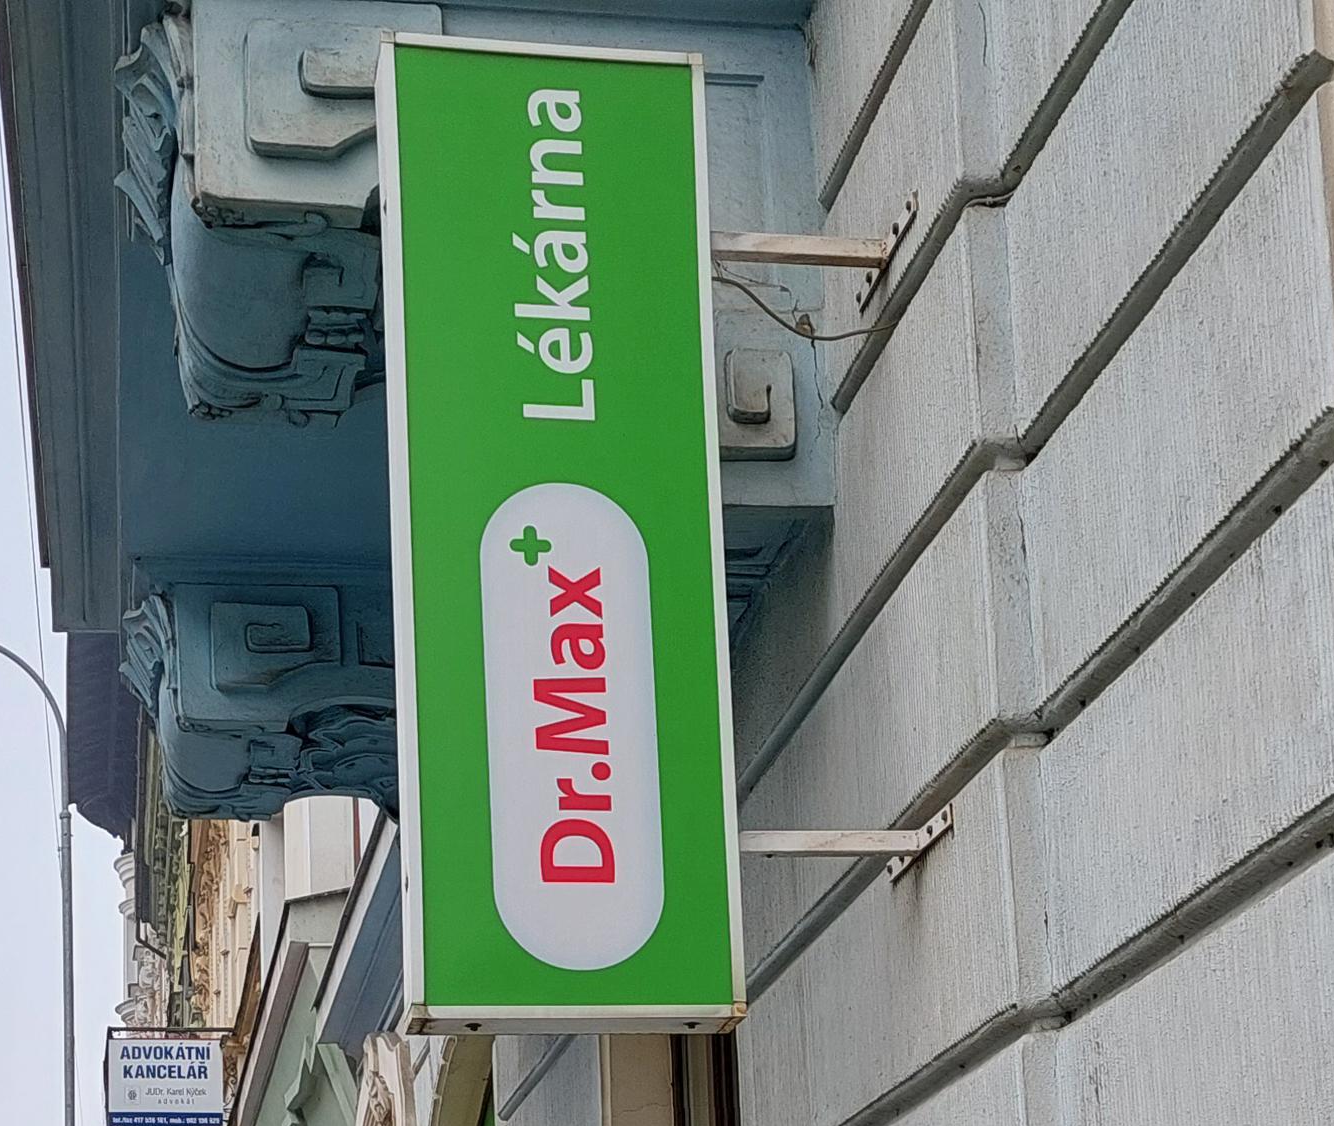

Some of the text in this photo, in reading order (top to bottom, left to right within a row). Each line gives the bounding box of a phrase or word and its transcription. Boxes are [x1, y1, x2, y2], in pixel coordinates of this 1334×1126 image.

[513, 87, 596, 421] Lékárna
[120, 1042, 211, 1060] ADVOKÁTNÍ
[123, 1061, 208, 1079] KANCELÁŘ
